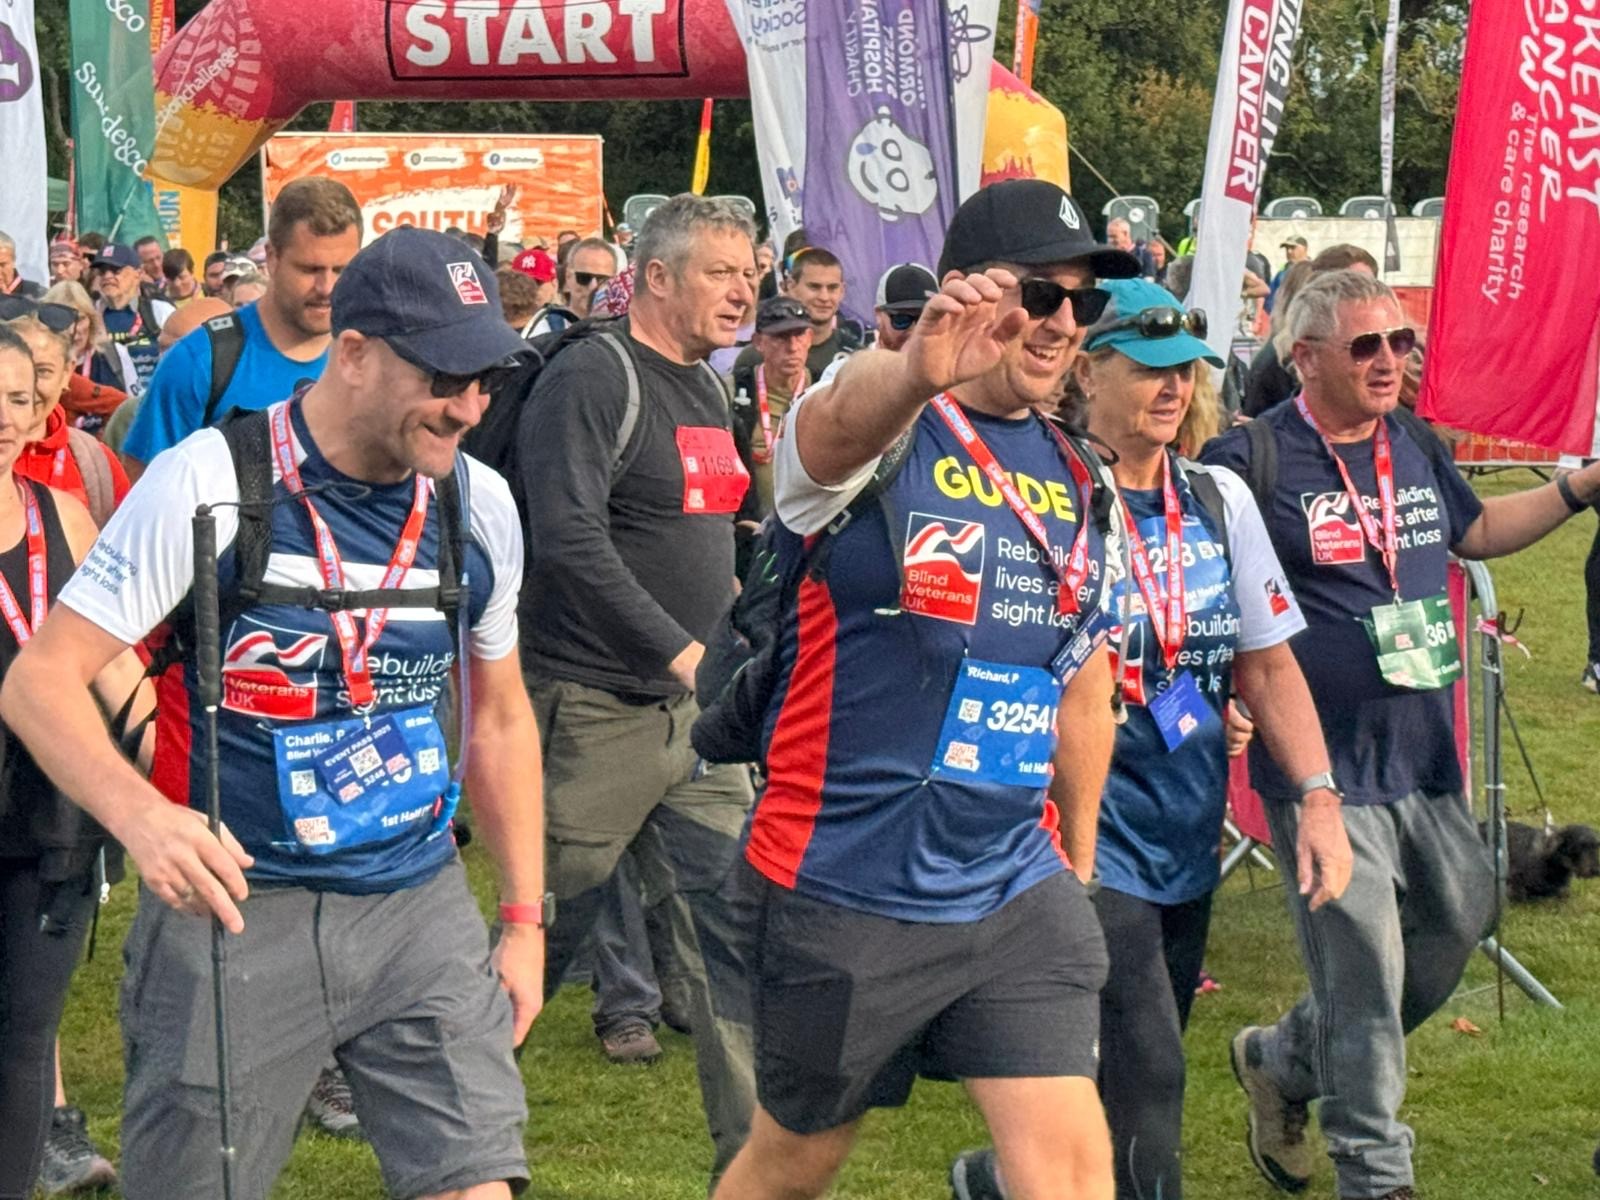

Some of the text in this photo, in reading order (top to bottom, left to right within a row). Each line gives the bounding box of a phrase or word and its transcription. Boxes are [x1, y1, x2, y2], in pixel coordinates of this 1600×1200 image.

[404, 0, 666, 66] START
[1229, 5, 1270, 193] CANCER
[1481, 102, 1526, 305] & care charity
[1507, 112, 1539, 300] The research
[1361, 486, 1437, 510] Reuilding
[1406, 507, 1440, 525] after
[1412, 529, 1442, 546] loss
[908, 569, 949, 586] Blind
[994, 566, 1096, 604] lives aer
[904, 595, 928, 610] UK
[906, 584, 973, 605] Veterans
[992, 599, 1045, 627] sight
[229, 678, 310, 697] Veterans
[229, 692, 256, 708] UK
[986, 700, 1050, 735] 3254
[285, 729, 346, 748] Charlie, P
[381, 815, 398, 827] 1st
